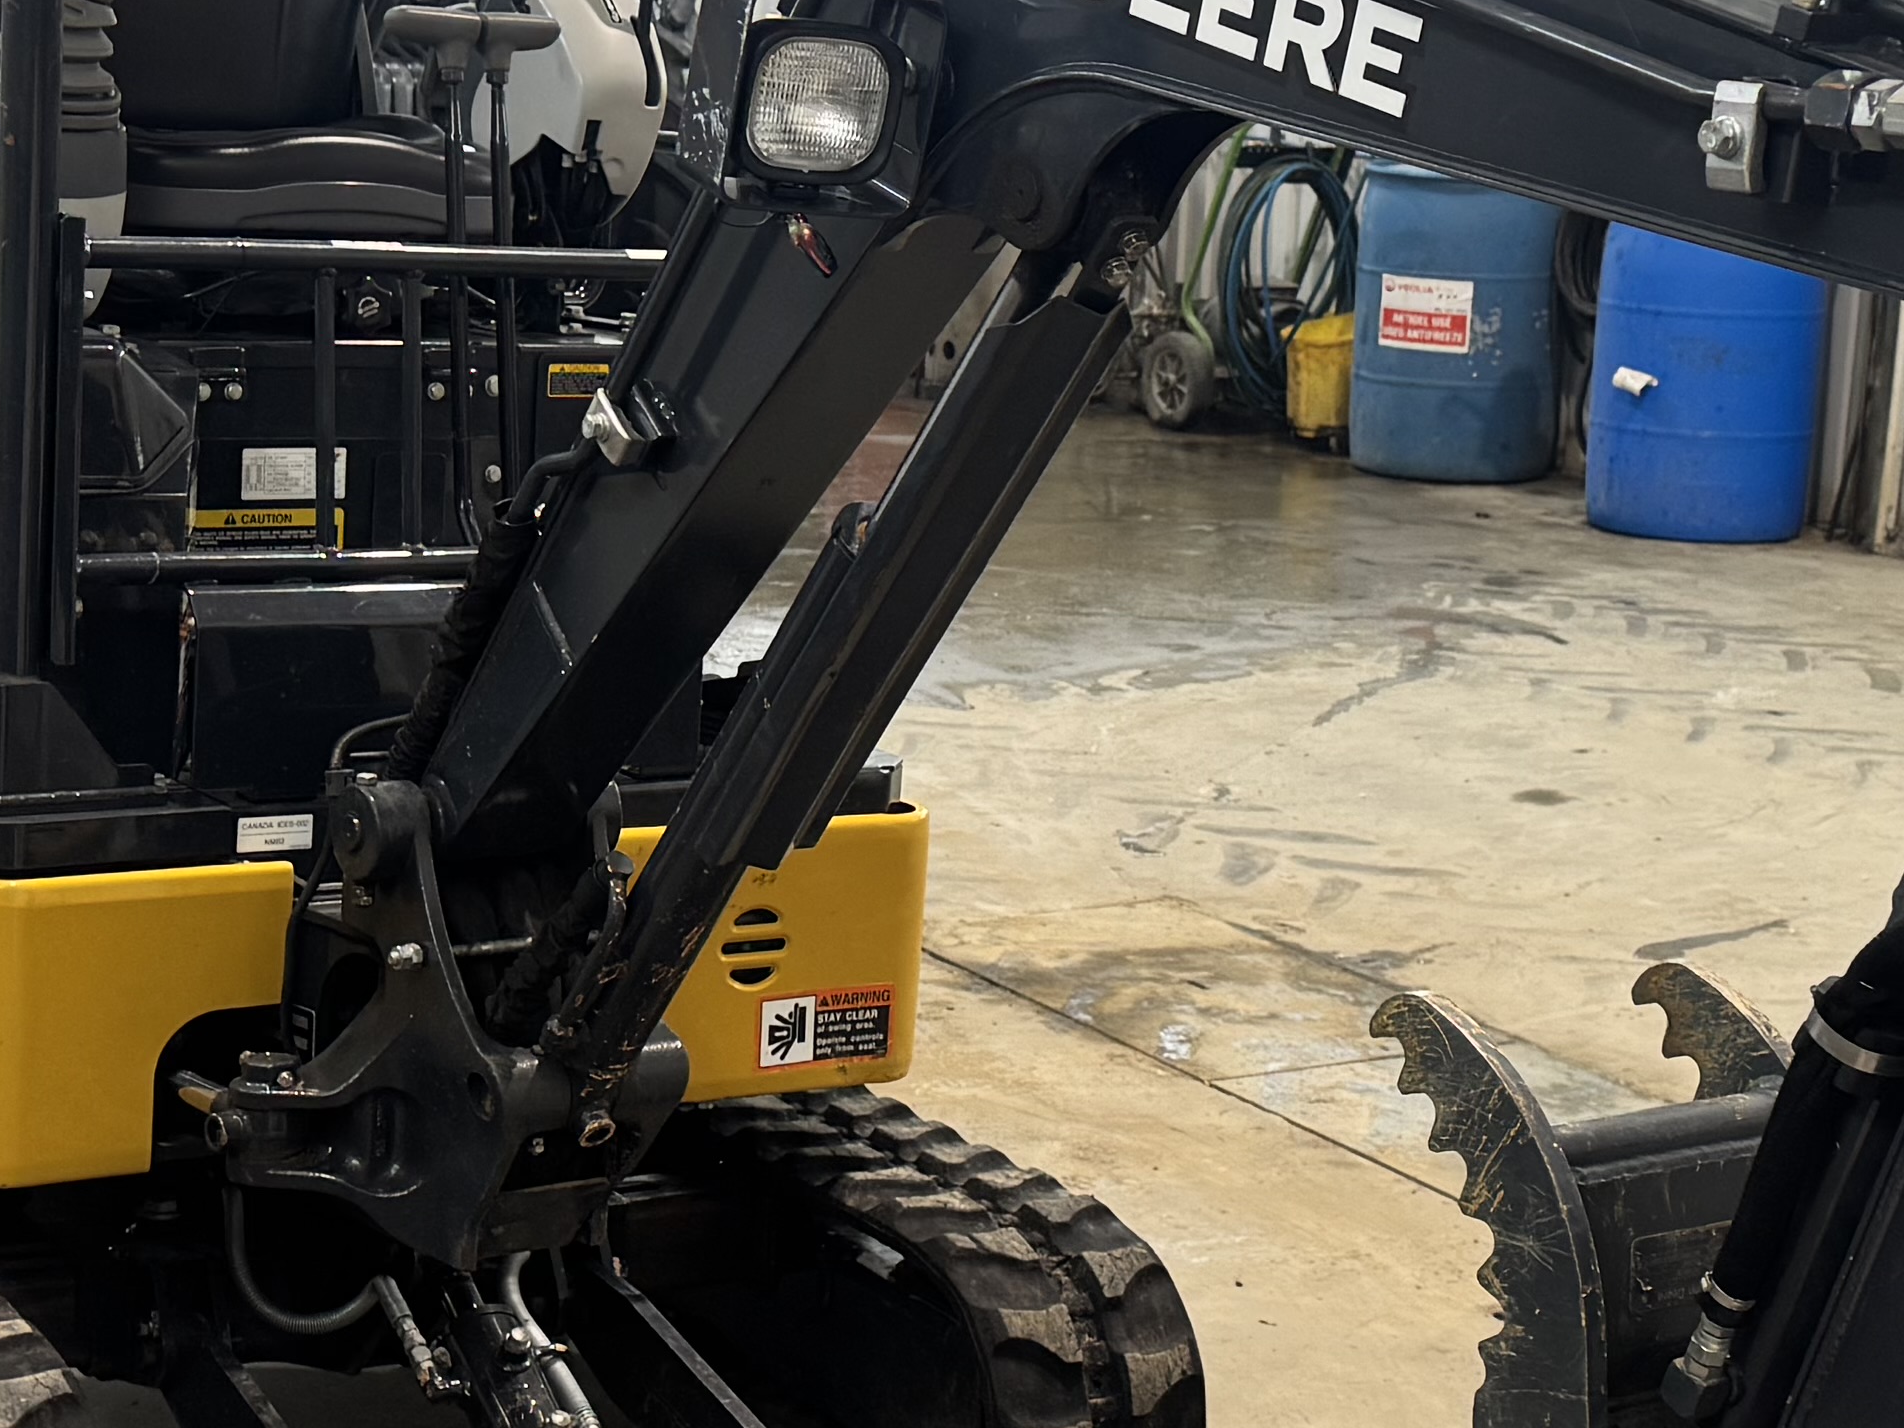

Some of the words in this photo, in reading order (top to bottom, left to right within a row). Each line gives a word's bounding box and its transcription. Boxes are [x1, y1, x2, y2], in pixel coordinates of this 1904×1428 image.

[240, 513, 293, 525] CAUTION
[241, 821, 274, 831] CANADA
[830, 989, 891, 1007] WARNING
[817, 1012, 842, 1024] STAY
[846, 1008, 879, 1022] CLEAR
[816, 1025, 826, 1034] of
[828, 1023, 852, 1033] swing
[816, 1035, 846, 1047] Operate
[850, 1032, 884, 1043] controls
[816, 1046, 832, 1056] only
[835, 1043, 855, 1052] from
